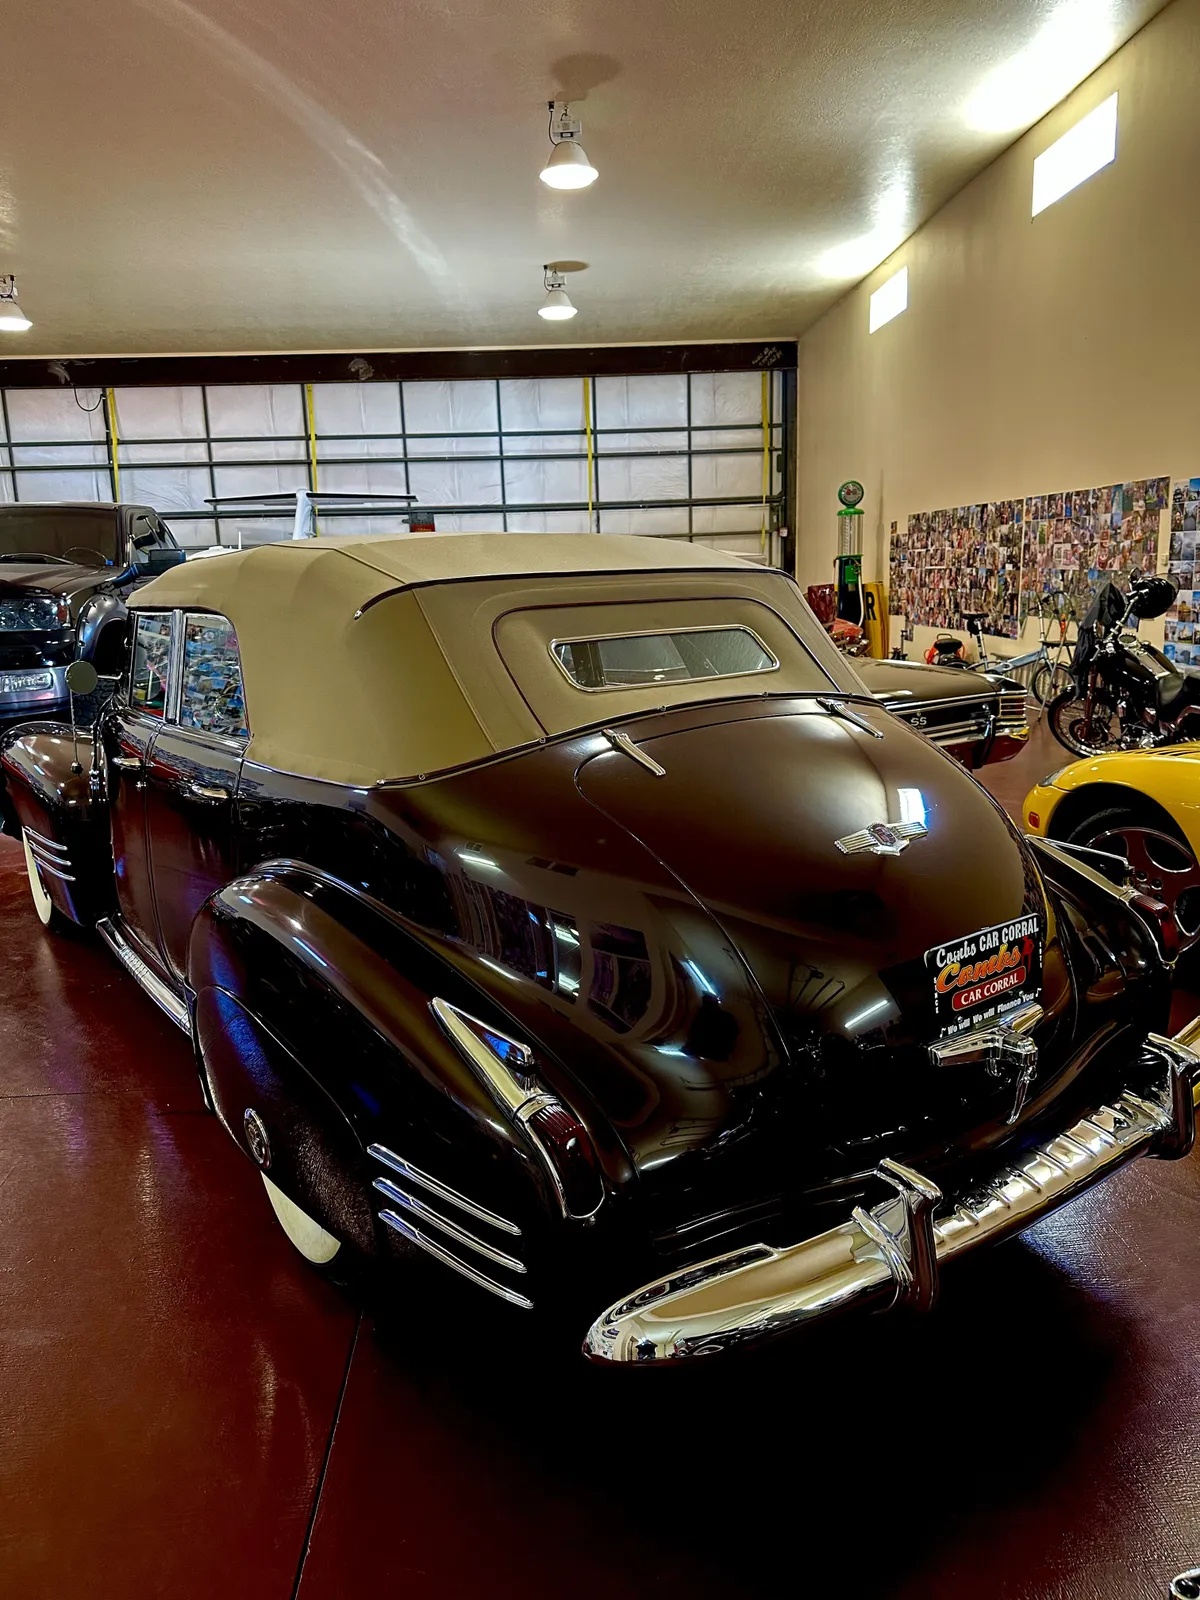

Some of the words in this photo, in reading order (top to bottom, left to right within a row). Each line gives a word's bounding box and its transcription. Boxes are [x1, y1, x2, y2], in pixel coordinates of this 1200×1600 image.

[866, 591, 877, 620] R
[910, 716, 927, 726] SS
[936, 940, 976, 968] Combs
[980, 931, 999, 952] CAR
[1002, 917, 1039, 944] CORRAL
[936, 942, 1021, 993] Combs
[961, 991, 982, 1005] CAR
[984, 972, 1018, 996] CORRAL
[947, 1025, 958, 1035] We
[958, 1017, 971, 1029] will
[973, 1013, 983, 1024] We
[983, 1007, 995, 1019] will
[997, 998, 1021, 1013] Finance
[1022, 992, 1034, 1003] You
